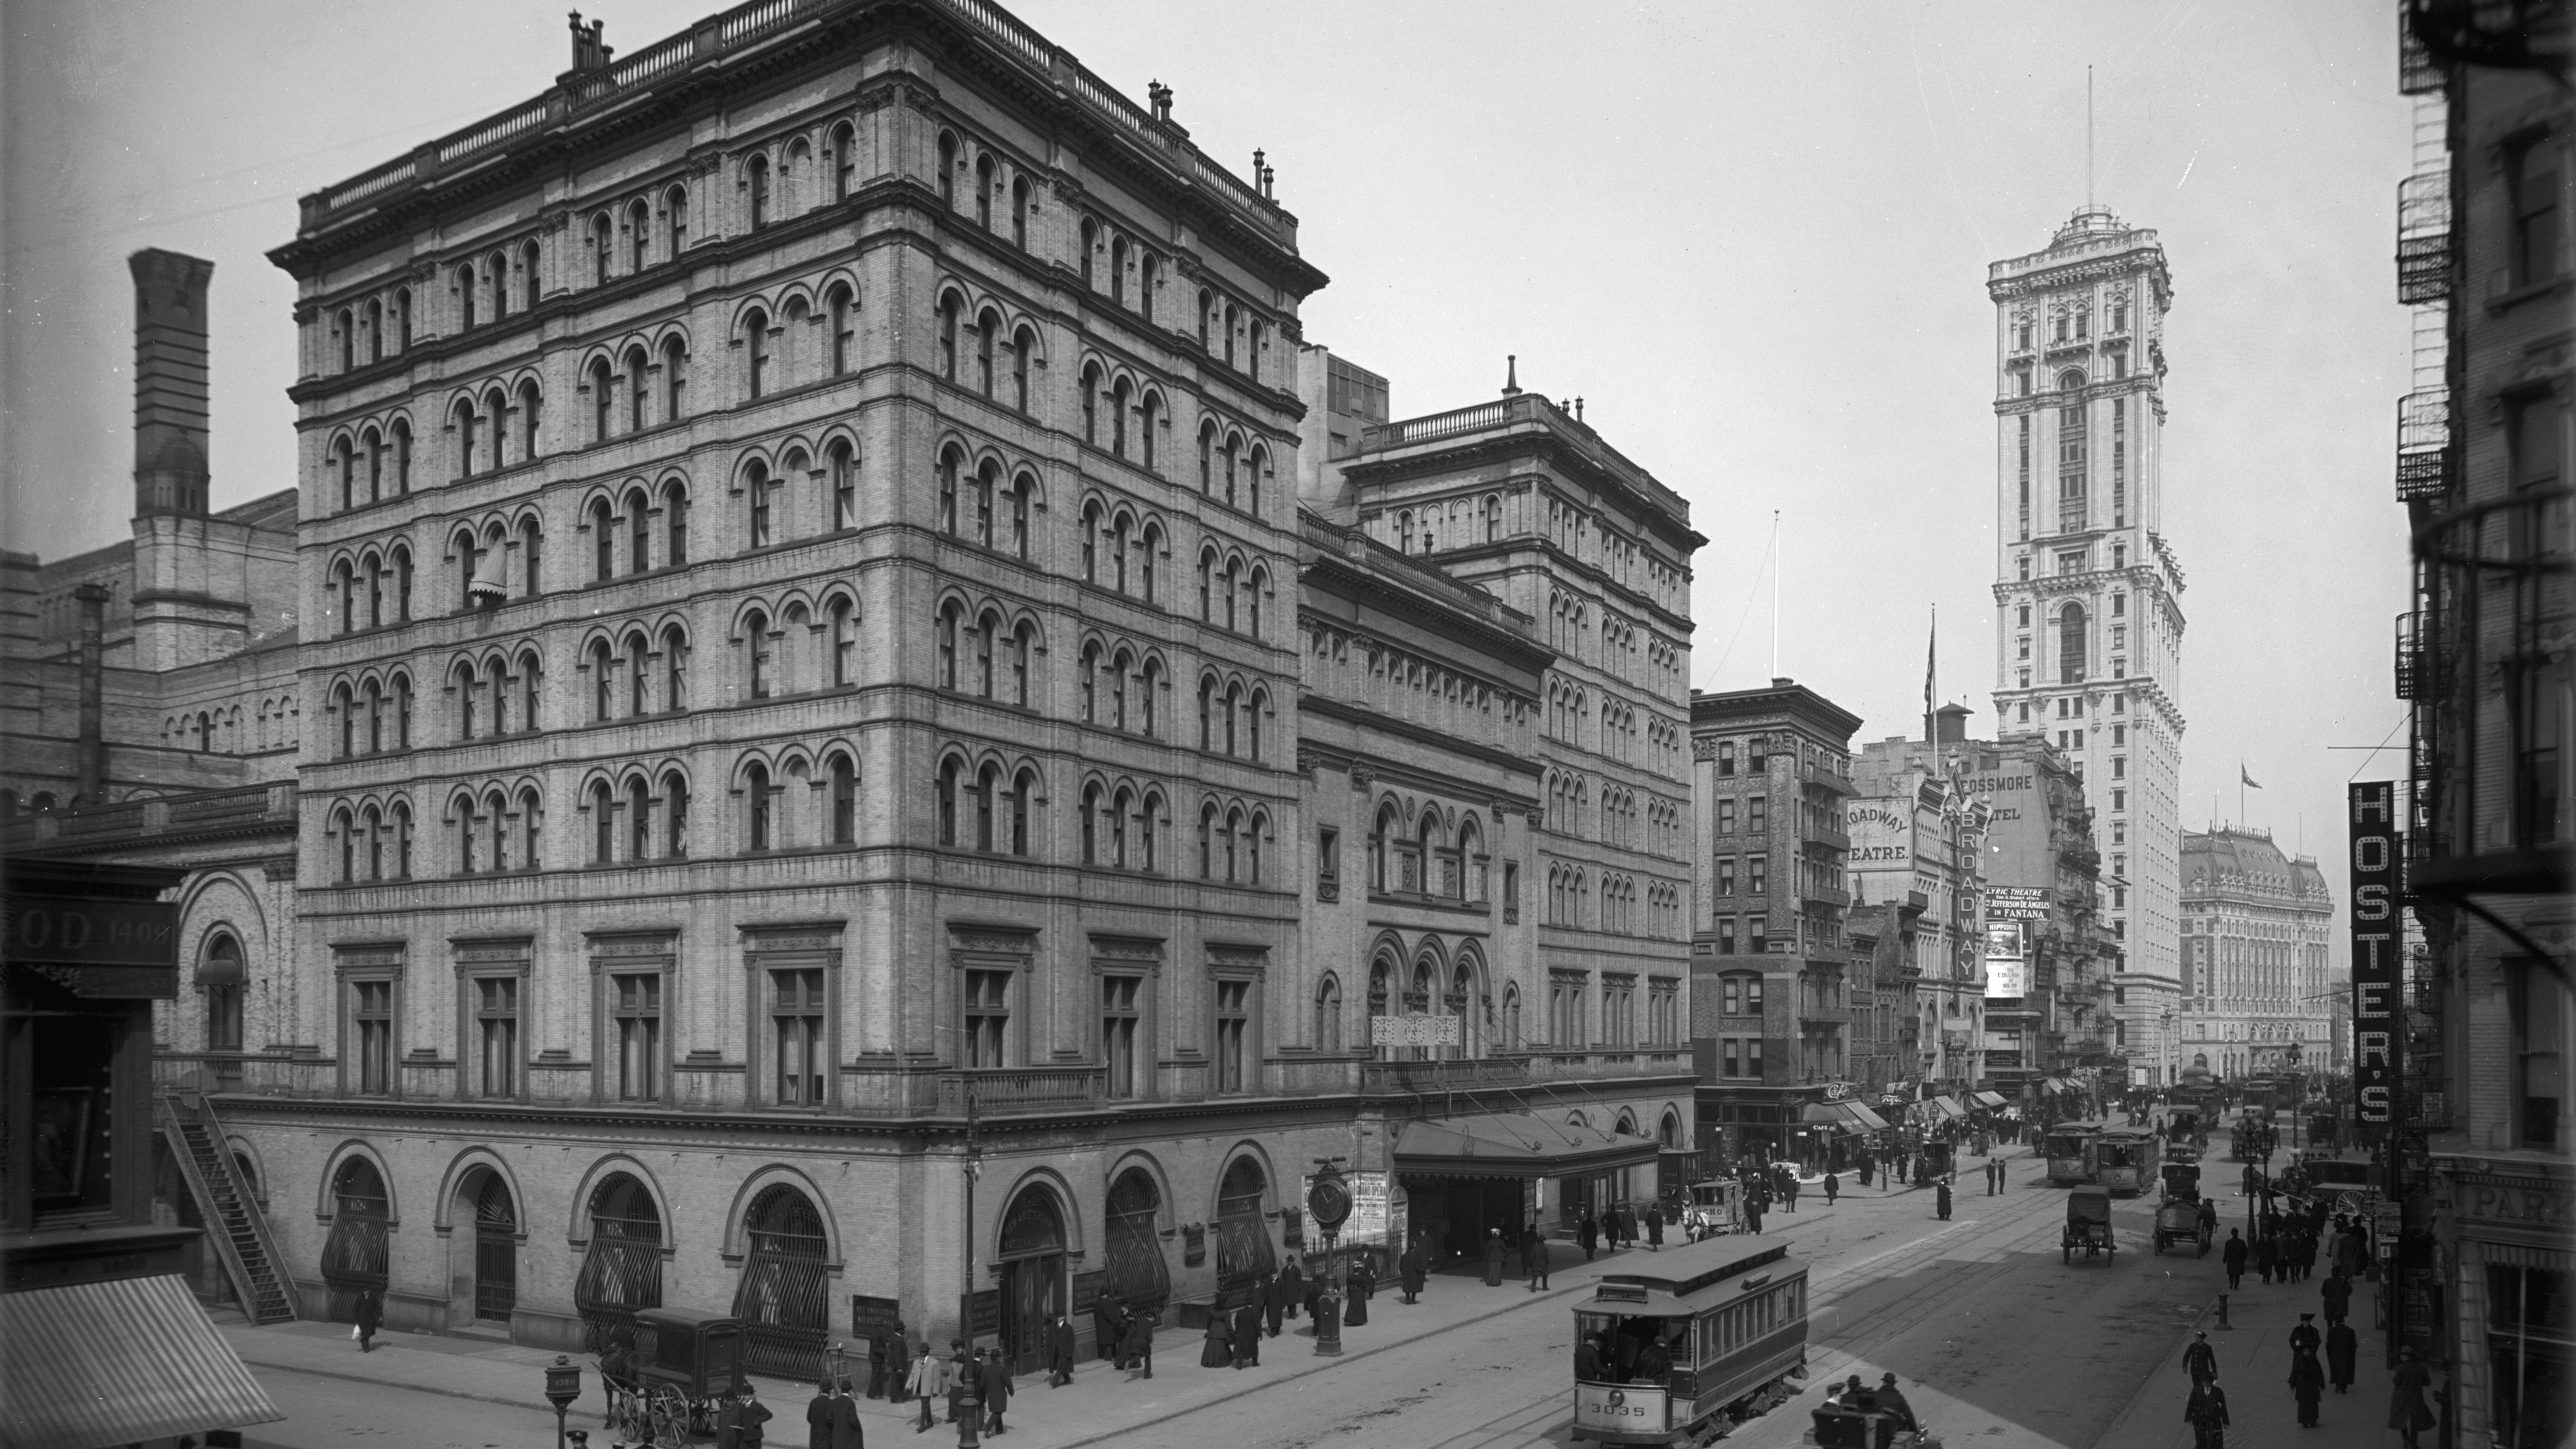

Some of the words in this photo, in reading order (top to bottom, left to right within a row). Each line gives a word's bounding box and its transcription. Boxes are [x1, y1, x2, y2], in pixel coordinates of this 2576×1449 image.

[1994, 808, 2021, 821] TEL
[1848, 809, 1908, 834] OADWAY
[1848, 846, 1909, 861] EATRE.
[1961, 813, 1975, 975] BROADWAY
[2004, 909, 2044, 918] FANTANA
[2354, 787, 2390, 1122] HOSTER'S
[2087, 1067, 2101, 1077] LEVY
[1371, 1186, 1386, 1196] OPERA
[1602, 1289, 1644, 1297] BROADWAY
[1591, 1403, 1646, 1417] 3035
